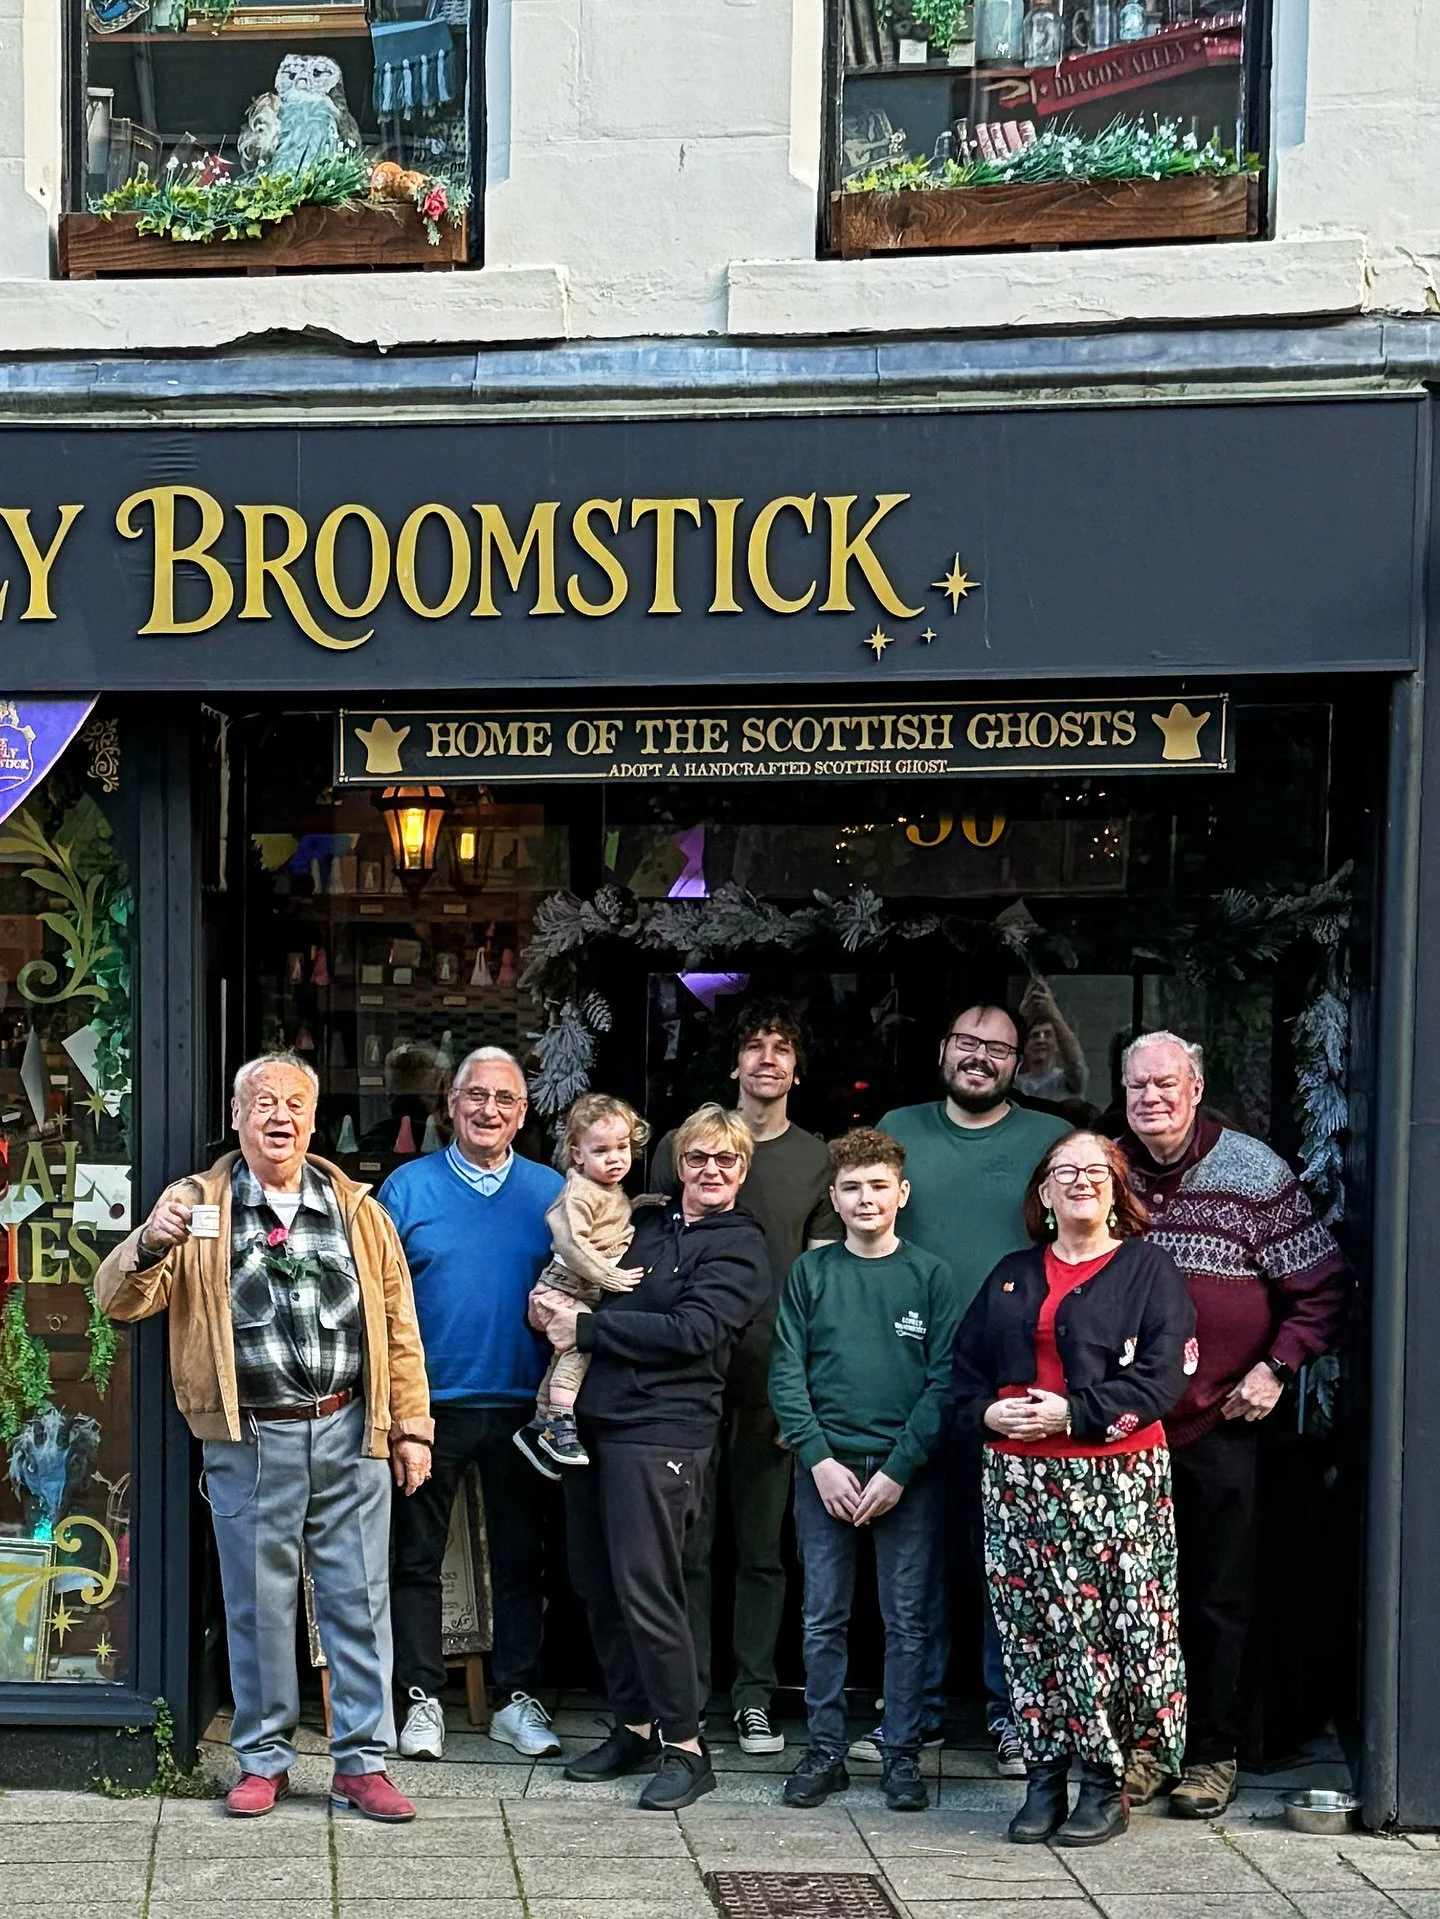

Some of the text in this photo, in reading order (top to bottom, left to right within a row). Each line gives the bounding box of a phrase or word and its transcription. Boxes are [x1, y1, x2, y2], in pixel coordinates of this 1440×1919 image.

[1054, 40, 1187, 98] DIAGON ALLEY
[0, 485, 925, 651] Y BROOMSTICK
[426, 709, 1137, 758] HOME OF THE SCOTTISH GHOSTS
[609, 759, 948, 778] ADOPT A HANDCRAFTED SCOTTISH GHOST
